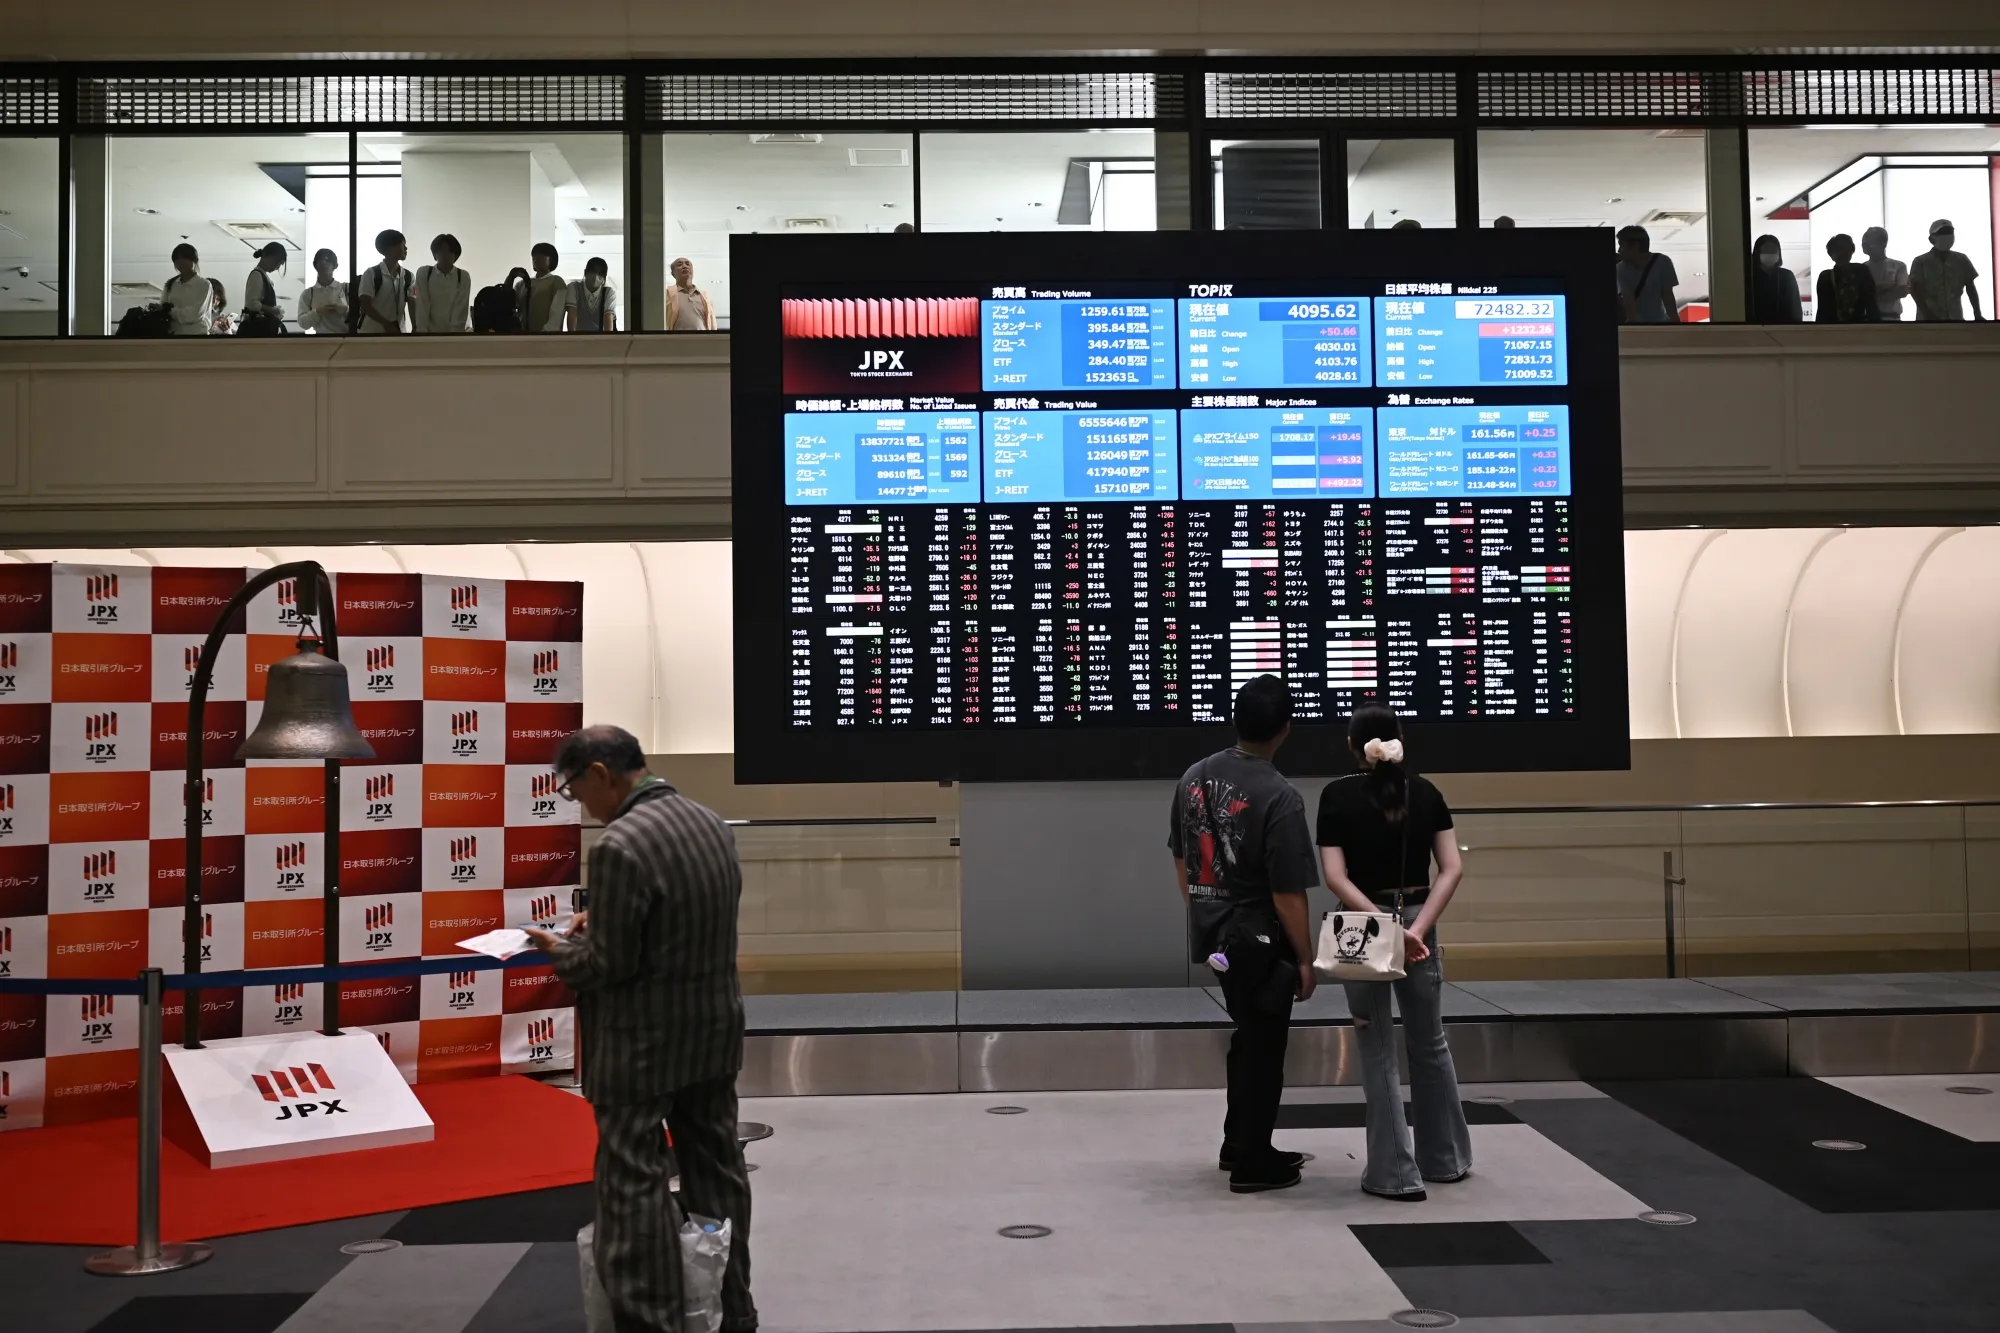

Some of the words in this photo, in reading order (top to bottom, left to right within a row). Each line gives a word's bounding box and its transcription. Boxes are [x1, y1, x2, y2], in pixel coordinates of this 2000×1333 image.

[992, 287, 1026, 298] 売買高
[1189, 285, 1233, 297] TOPIX
[1385, 284, 1452, 295] 日経平均株価
[992, 306, 1025, 314] プライム
[1081, 307, 1125, 316] 1259.61
[1189, 304, 1229, 316] 現在値
[1288, 305, 1356, 318] 4095.62
[1385, 302, 1424, 314] 現在値
[1475, 304, 1551, 316] 72482.32
[992, 322, 1041, 331] スタンダード
[1088, 323, 1125, 333] 395.84
[1502, 325, 1551, 334] +1232.26
[1189, 329, 1216, 338] 前日比
[1386, 327, 1412, 336] 前日比
[992, 339, 1026, 348] グロース
[1088, 340, 1125, 349] 349.47
[1314, 343, 1356, 351] 4030.01
[1504, 341, 1552, 349] 71067.15
[858, 351, 904, 369] JPX
[993, 358, 1012, 366] ETF
[1089, 356, 1126, 365] 284.40
[1222, 360, 1238, 368] High
[1315, 357, 1357, 366] 4103.76
[1419, 358, 1434, 366] High
[1504, 355, 1552, 364] 72831.73
[993, 374, 1027, 383] J-REIT
[1086, 373, 1126, 382] 152363
[1315, 372, 1357, 380] 4028.61
[1505, 370, 1553, 378] 71009.52
[994, 398, 1039, 409] 売買代金
[1045, 401, 1073, 409] Trading
[1192, 396, 1259, 407] 主要株価指数
[1266, 399, 1287, 407] Major
[1388, 395, 1410, 405] 為替
[994, 417, 1027, 425] プライム
[1079, 418, 1127, 427] 6555646
[1429, 428, 1456, 436] 対ドル
[1471, 429, 1515, 438] 161.56円
[1525, 429, 1555, 437] +0.25
[796, 436, 826, 444] プライム
[861, 437, 905, 446] 13837721
[994, 433, 1043, 442] スタンダード
[1087, 435, 1127, 443] 151165
[1331, 433, 1360, 441] +19.45
[796, 453, 841, 461] スタンダード
[871, 454, 905, 462] 331324
[995, 450, 1028, 458] グロース
[1087, 451, 1128, 460] 126049
[877, 471, 905, 479] 89610
[951, 470, 967, 478] 592
[995, 469, 1013, 477] ETF
[1087, 467, 1128, 476] 417940
[796, 488, 828, 496] J-REIT
[878, 488, 905, 496] 14477
[995, 486, 1029, 494] J-REIT
[1094, 484, 1128, 493] 15710
[160, 597, 232, 605] 日本取引所グルー
[344, 601, 414, 609] 日本取引所グループ
[88, 605, 117, 617] JPX
[513, 607, 577, 616] 日本取引所グループ
[452, 614, 477, 624] JPX
[61, 664, 142, 673] 日本取引所グループ
[430, 665, 497, 675] 日本取引所グループ
[368, 675, 393, 686] JPX
[534, 678, 557, 689] JPX
[86, 744, 116, 755] JPX
[452, 740, 477, 750] JPX
[430, 792, 497, 801] 日本取引所グループ
[58, 802, 141, 813] 日本取引所グループ
[367, 803, 392, 815] JPX
[532, 801, 555, 811] JPX
[512, 851, 575, 862] 日本取引所グループ
[343, 857, 414, 868] 日本取引所グループ
[451, 865, 476, 876] JPX
[277, 873, 304, 884] JPX
[84, 883, 114, 895] JPX
[430, 917, 497, 928] 日本取引所グループ
[366, 933, 392, 945] JPX
[57, 940, 139, 954] 日本取引所グループ
[342, 985, 412, 1000] 日本取引所グループ
[449, 992, 474, 1003] JPX
[275, 1006, 302, 1018] JPX
[82, 1023, 112, 1036] JPX
[425, 1043, 492, 1055] 日本取引所グループ
[529, 1046, 553, 1058] JPX
[54, 1080, 137, 1097] 日本取引所グループ
[275, 1099, 348, 1121] JPX
